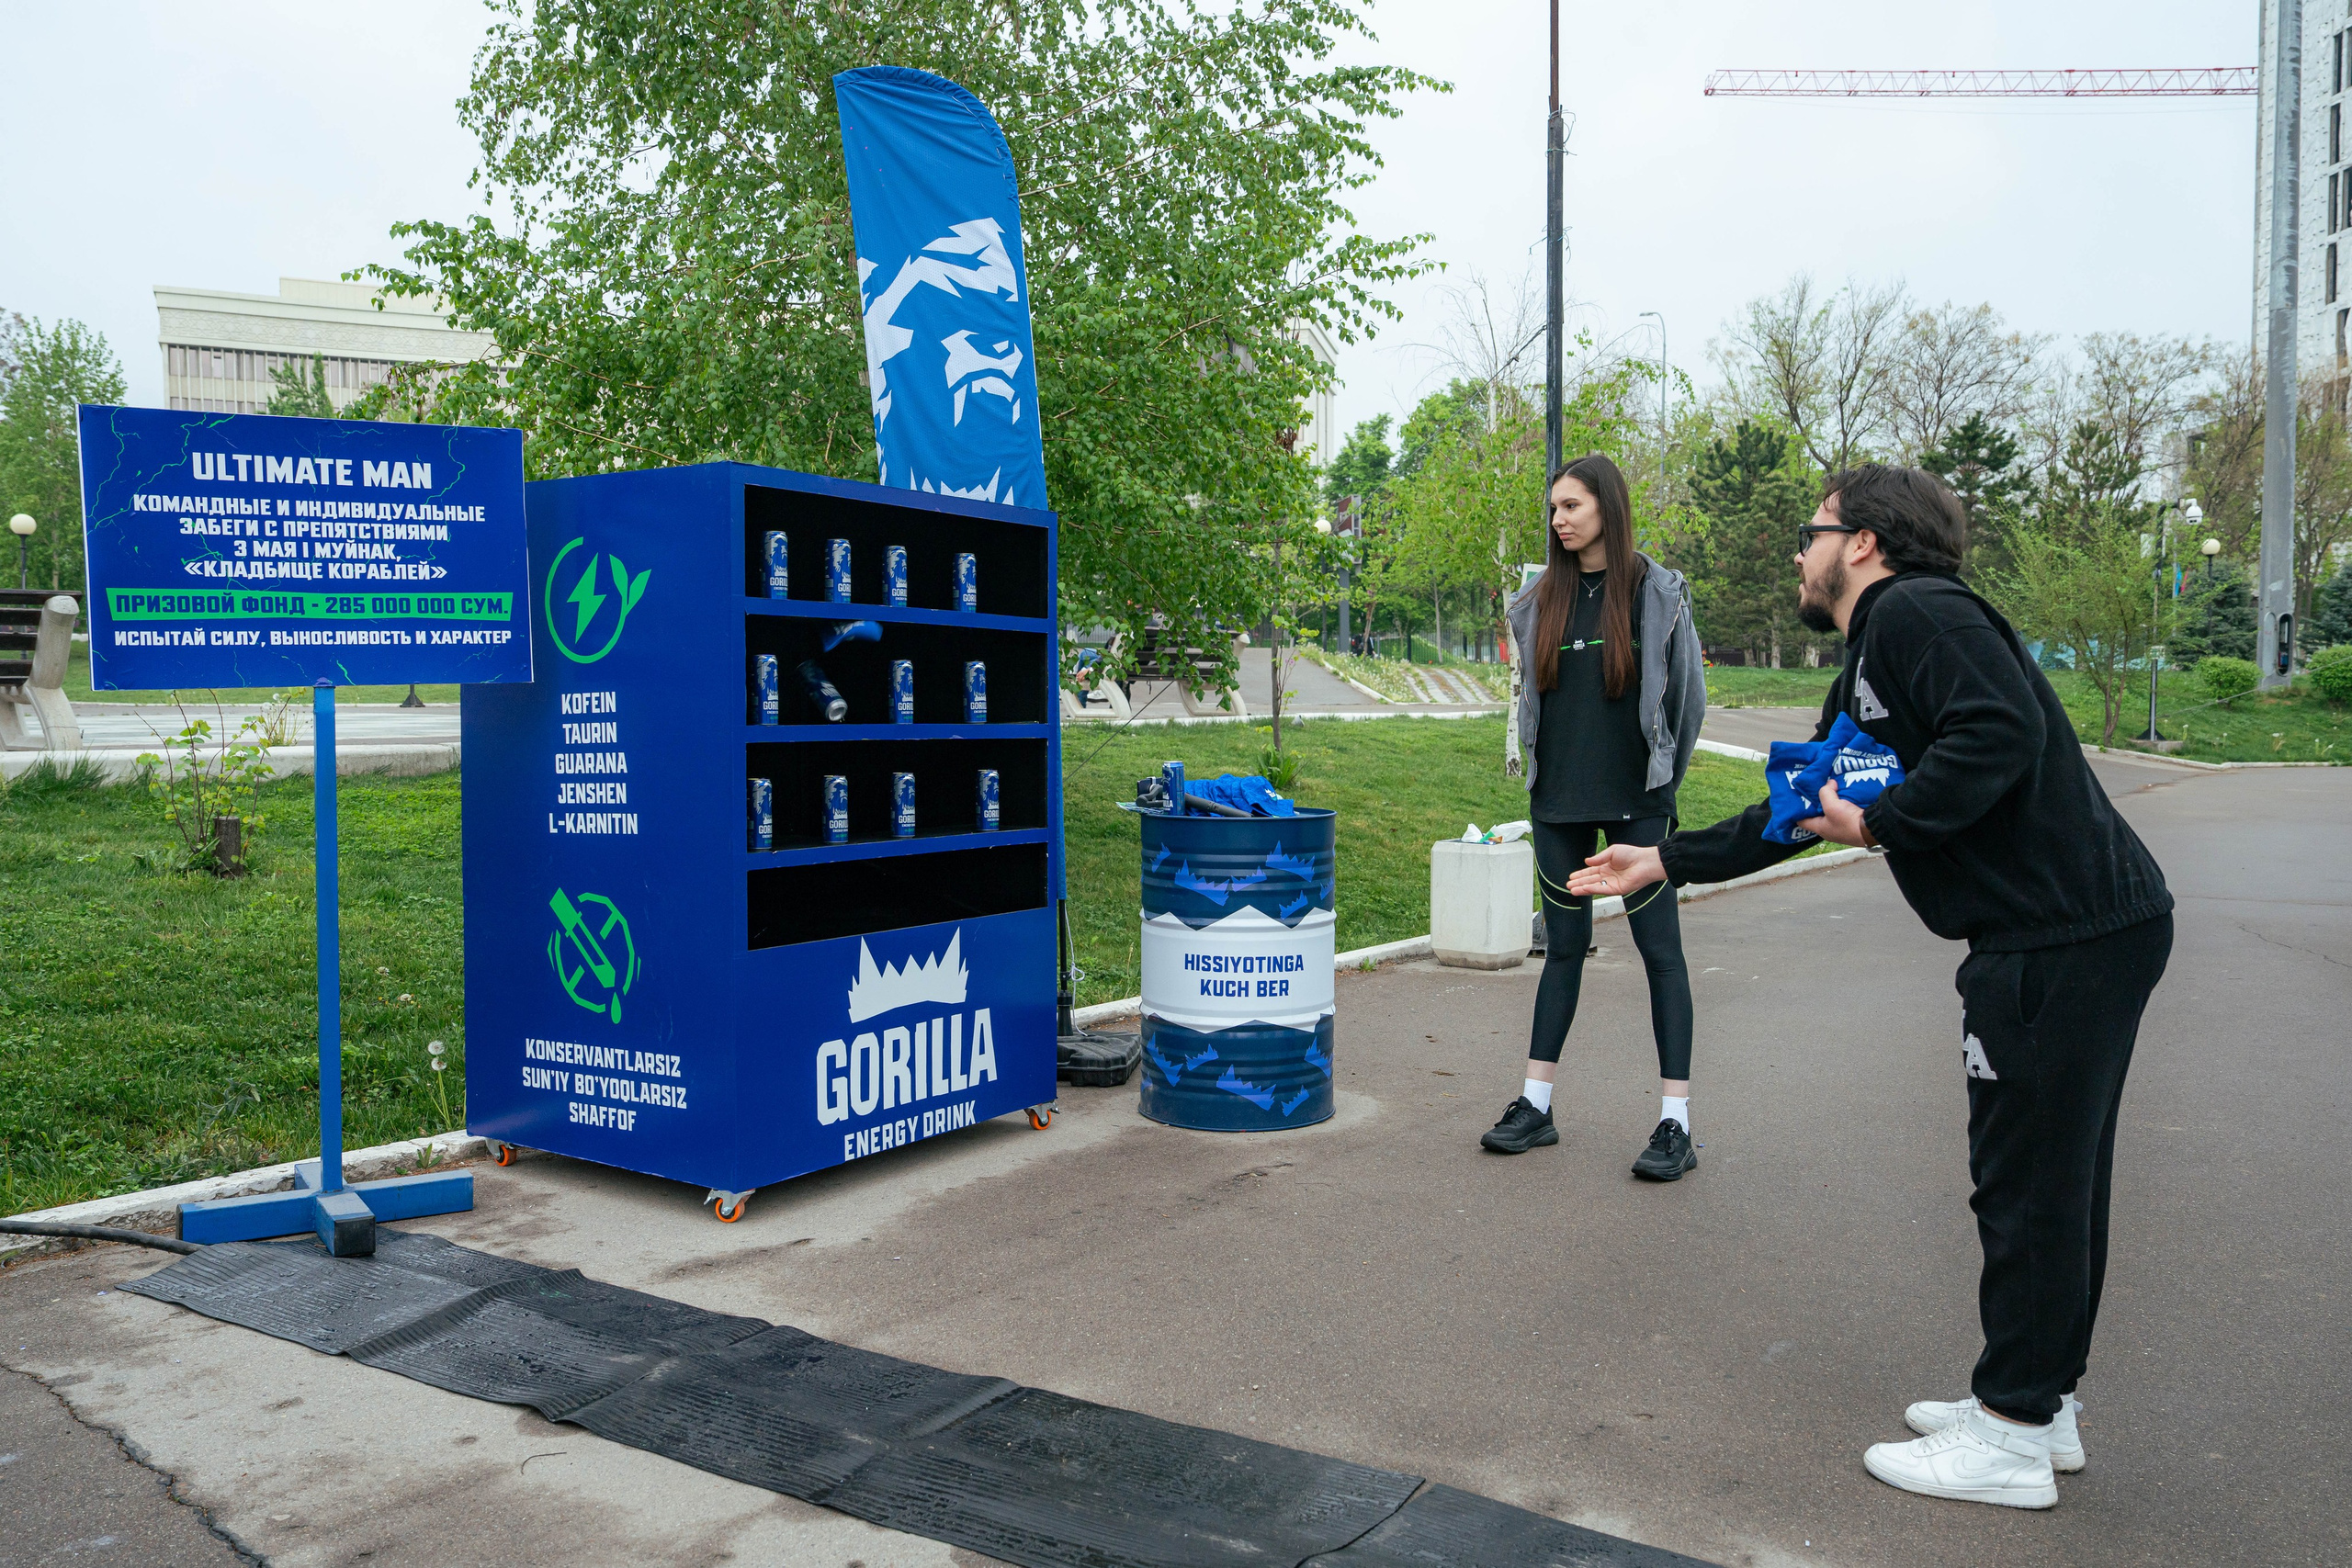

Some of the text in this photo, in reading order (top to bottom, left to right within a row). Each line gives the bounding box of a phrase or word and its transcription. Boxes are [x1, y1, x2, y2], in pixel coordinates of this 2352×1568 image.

[193, 452, 431, 489] ULTIMATE MAN
[134, 494, 485, 521] КОМАНДНЫЕ И ИНДИВИДУАЛЬНЫЕ
[180, 518, 447, 540] ЗАБЕГИ С ПРЕПЯТСТВИЯМИ
[254, 541, 297, 558] МАЯ
[315, 539, 401, 562] МУЙНАК,
[185, 561, 447, 580] «КЛАДБИЩЕ КОРАБЛЕЙ»
[117, 592, 234, 613] ПРИЗОВОЙ
[242, 596, 305, 615] ФОНД
[325, 597, 365, 613] 285
[372, 598, 410, 614] 000
[417, 598, 455, 614] 000
[461, 598, 508, 614] СУМ.
[115, 628, 511, 647] ИСПЫТАЙ СИЛУ, ВЫНОСЛИВОСТЬ И ХАРАКТЕР
[562, 692, 616, 714] KOFEIN
[563, 722, 616, 744] TAURIN
[556, 752, 628, 773] GUARANA
[559, 784, 626, 803] JENSHEN
[549, 813, 638, 834] L-KARNITIN
[1185, 953, 1304, 973] HISSIYOTINGA
[1201, 979, 1289, 997] KUCH BER
[525, 1038, 681, 1077] KONSERVANTLARSIZ
[817, 1008, 997, 1125] GORILLA
[570, 1102, 636, 1131] SHAFFOF
[845, 1100, 976, 1161] ENERGY DRINK
